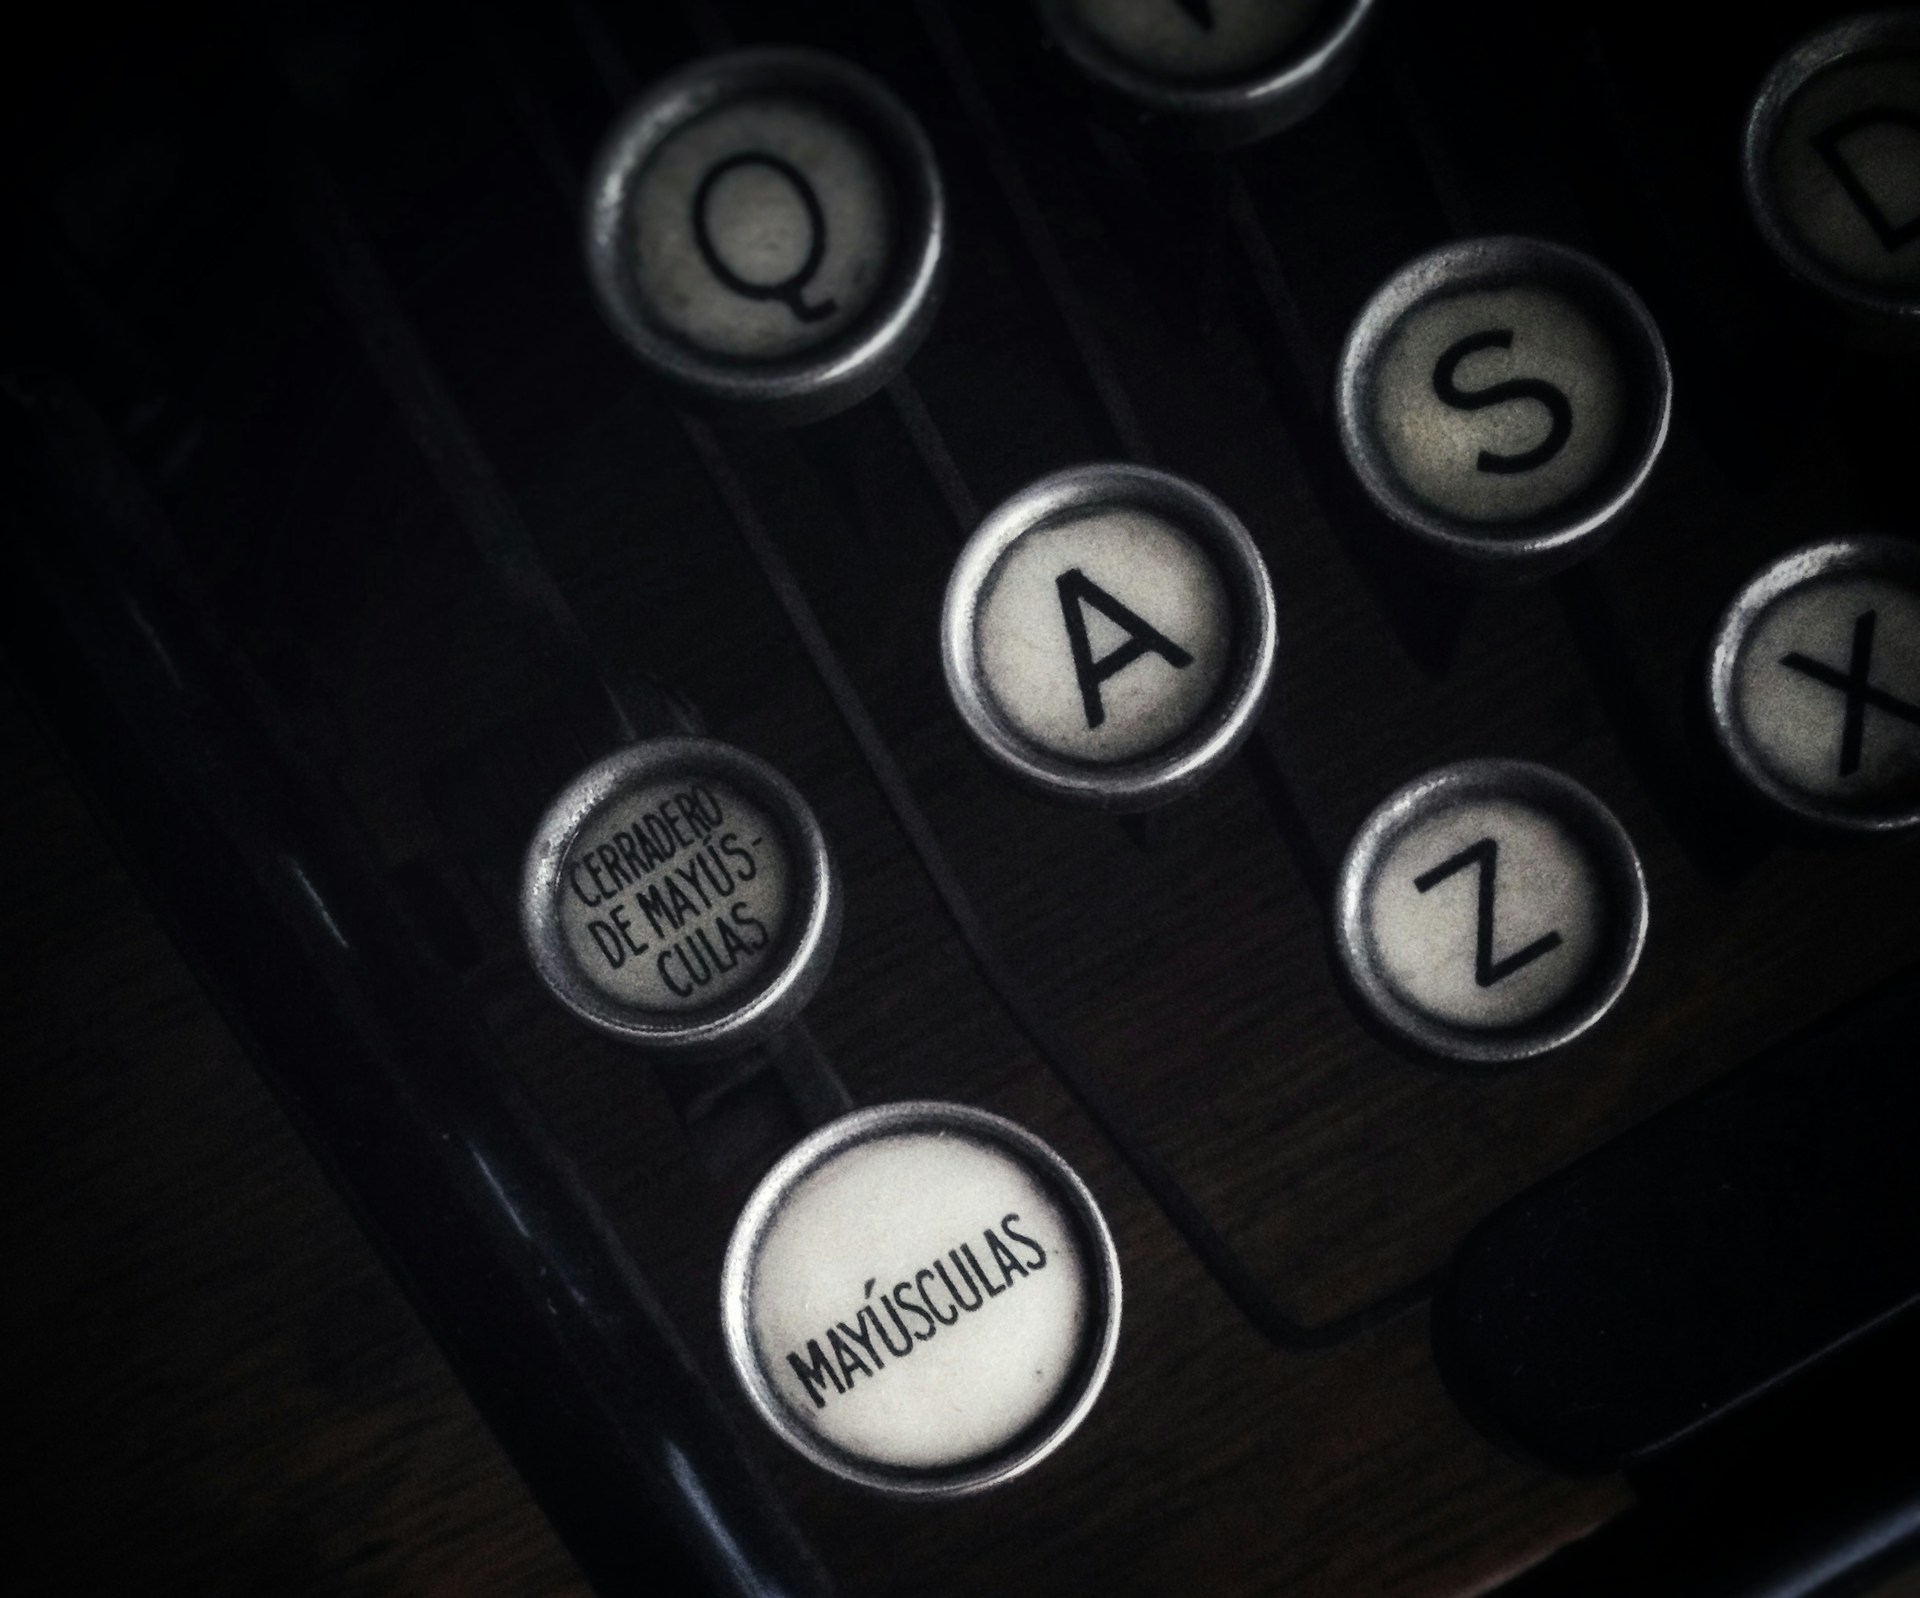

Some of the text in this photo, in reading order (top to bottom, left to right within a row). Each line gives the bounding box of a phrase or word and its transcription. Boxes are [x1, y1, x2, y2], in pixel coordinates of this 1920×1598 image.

[692, 151, 837, 324] Q
[1432, 329, 1573, 474] S
[1055, 567, 1193, 729] A
[1777, 609, 1920, 778] X
[570, 784, 723, 908] CERRADERO
[1413, 837, 1564, 988] Z
[588, 904, 649, 970] DE
[656, 902, 769, 998] CULAS
[786, 1213, 1047, 1409] MAYÚSCULAS
